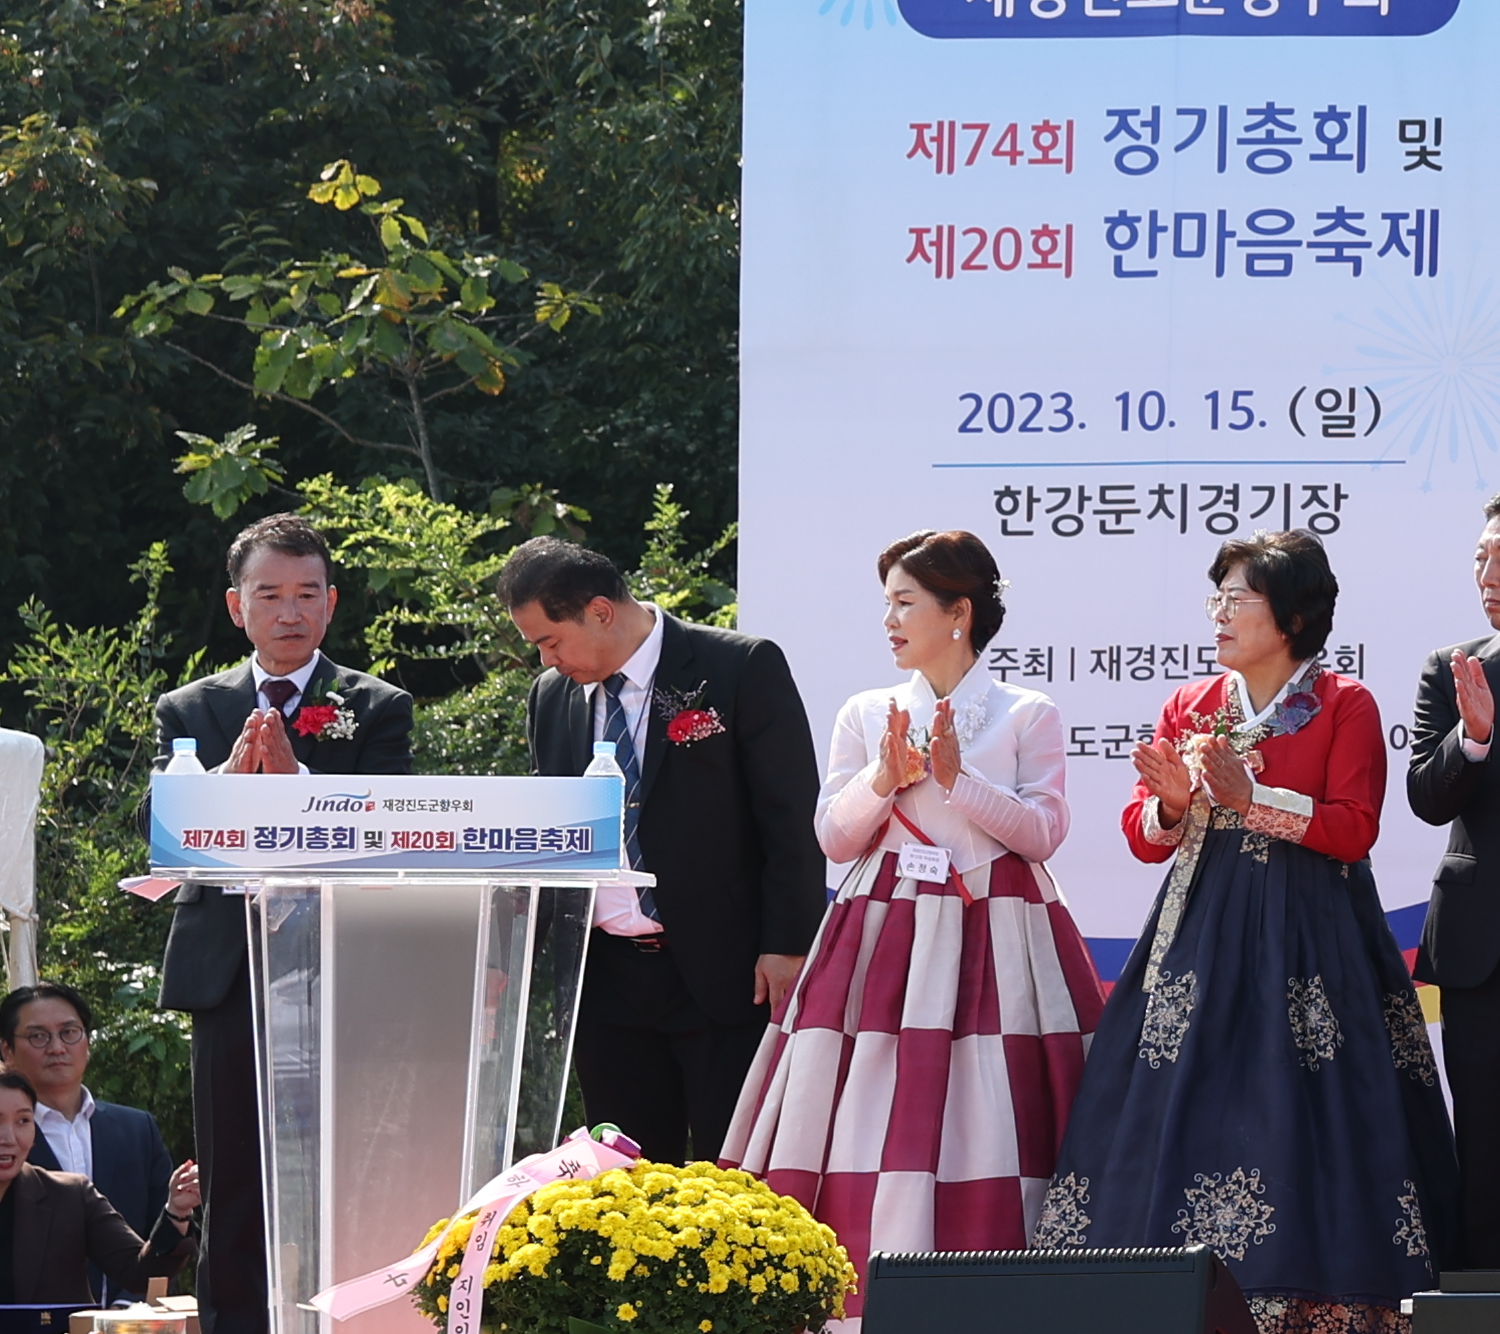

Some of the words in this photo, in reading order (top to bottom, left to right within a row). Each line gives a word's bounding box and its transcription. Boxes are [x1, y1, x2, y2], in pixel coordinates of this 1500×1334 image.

[905, 120, 1075, 176] 제74회
[1102, 103, 1369, 176] 정기총회
[1400, 118, 1444, 173] 및
[905, 222, 1075, 280] 제20회
[1103, 206, 1441, 278] 한마음축제
[958, 391, 1086, 434] 2023.
[1114, 391, 1176, 430] 10.
[1204, 390, 1267, 430] 15.
[1287, 386, 1383, 439] (일)
[994, 483, 1349, 537] 한강둔치경기장
[988, 646, 1054, 682] 주최
[302, 794, 364, 814] Jindo
[382, 798, 474, 813] 재경진도군향우회
[182, 828, 246, 850] 제74회
[253, 825, 357, 851] 정기총회
[364, 829, 383, 849] 및
[390, 829, 455, 851] 제20회
[462, 825, 592, 853] 한마음축제
